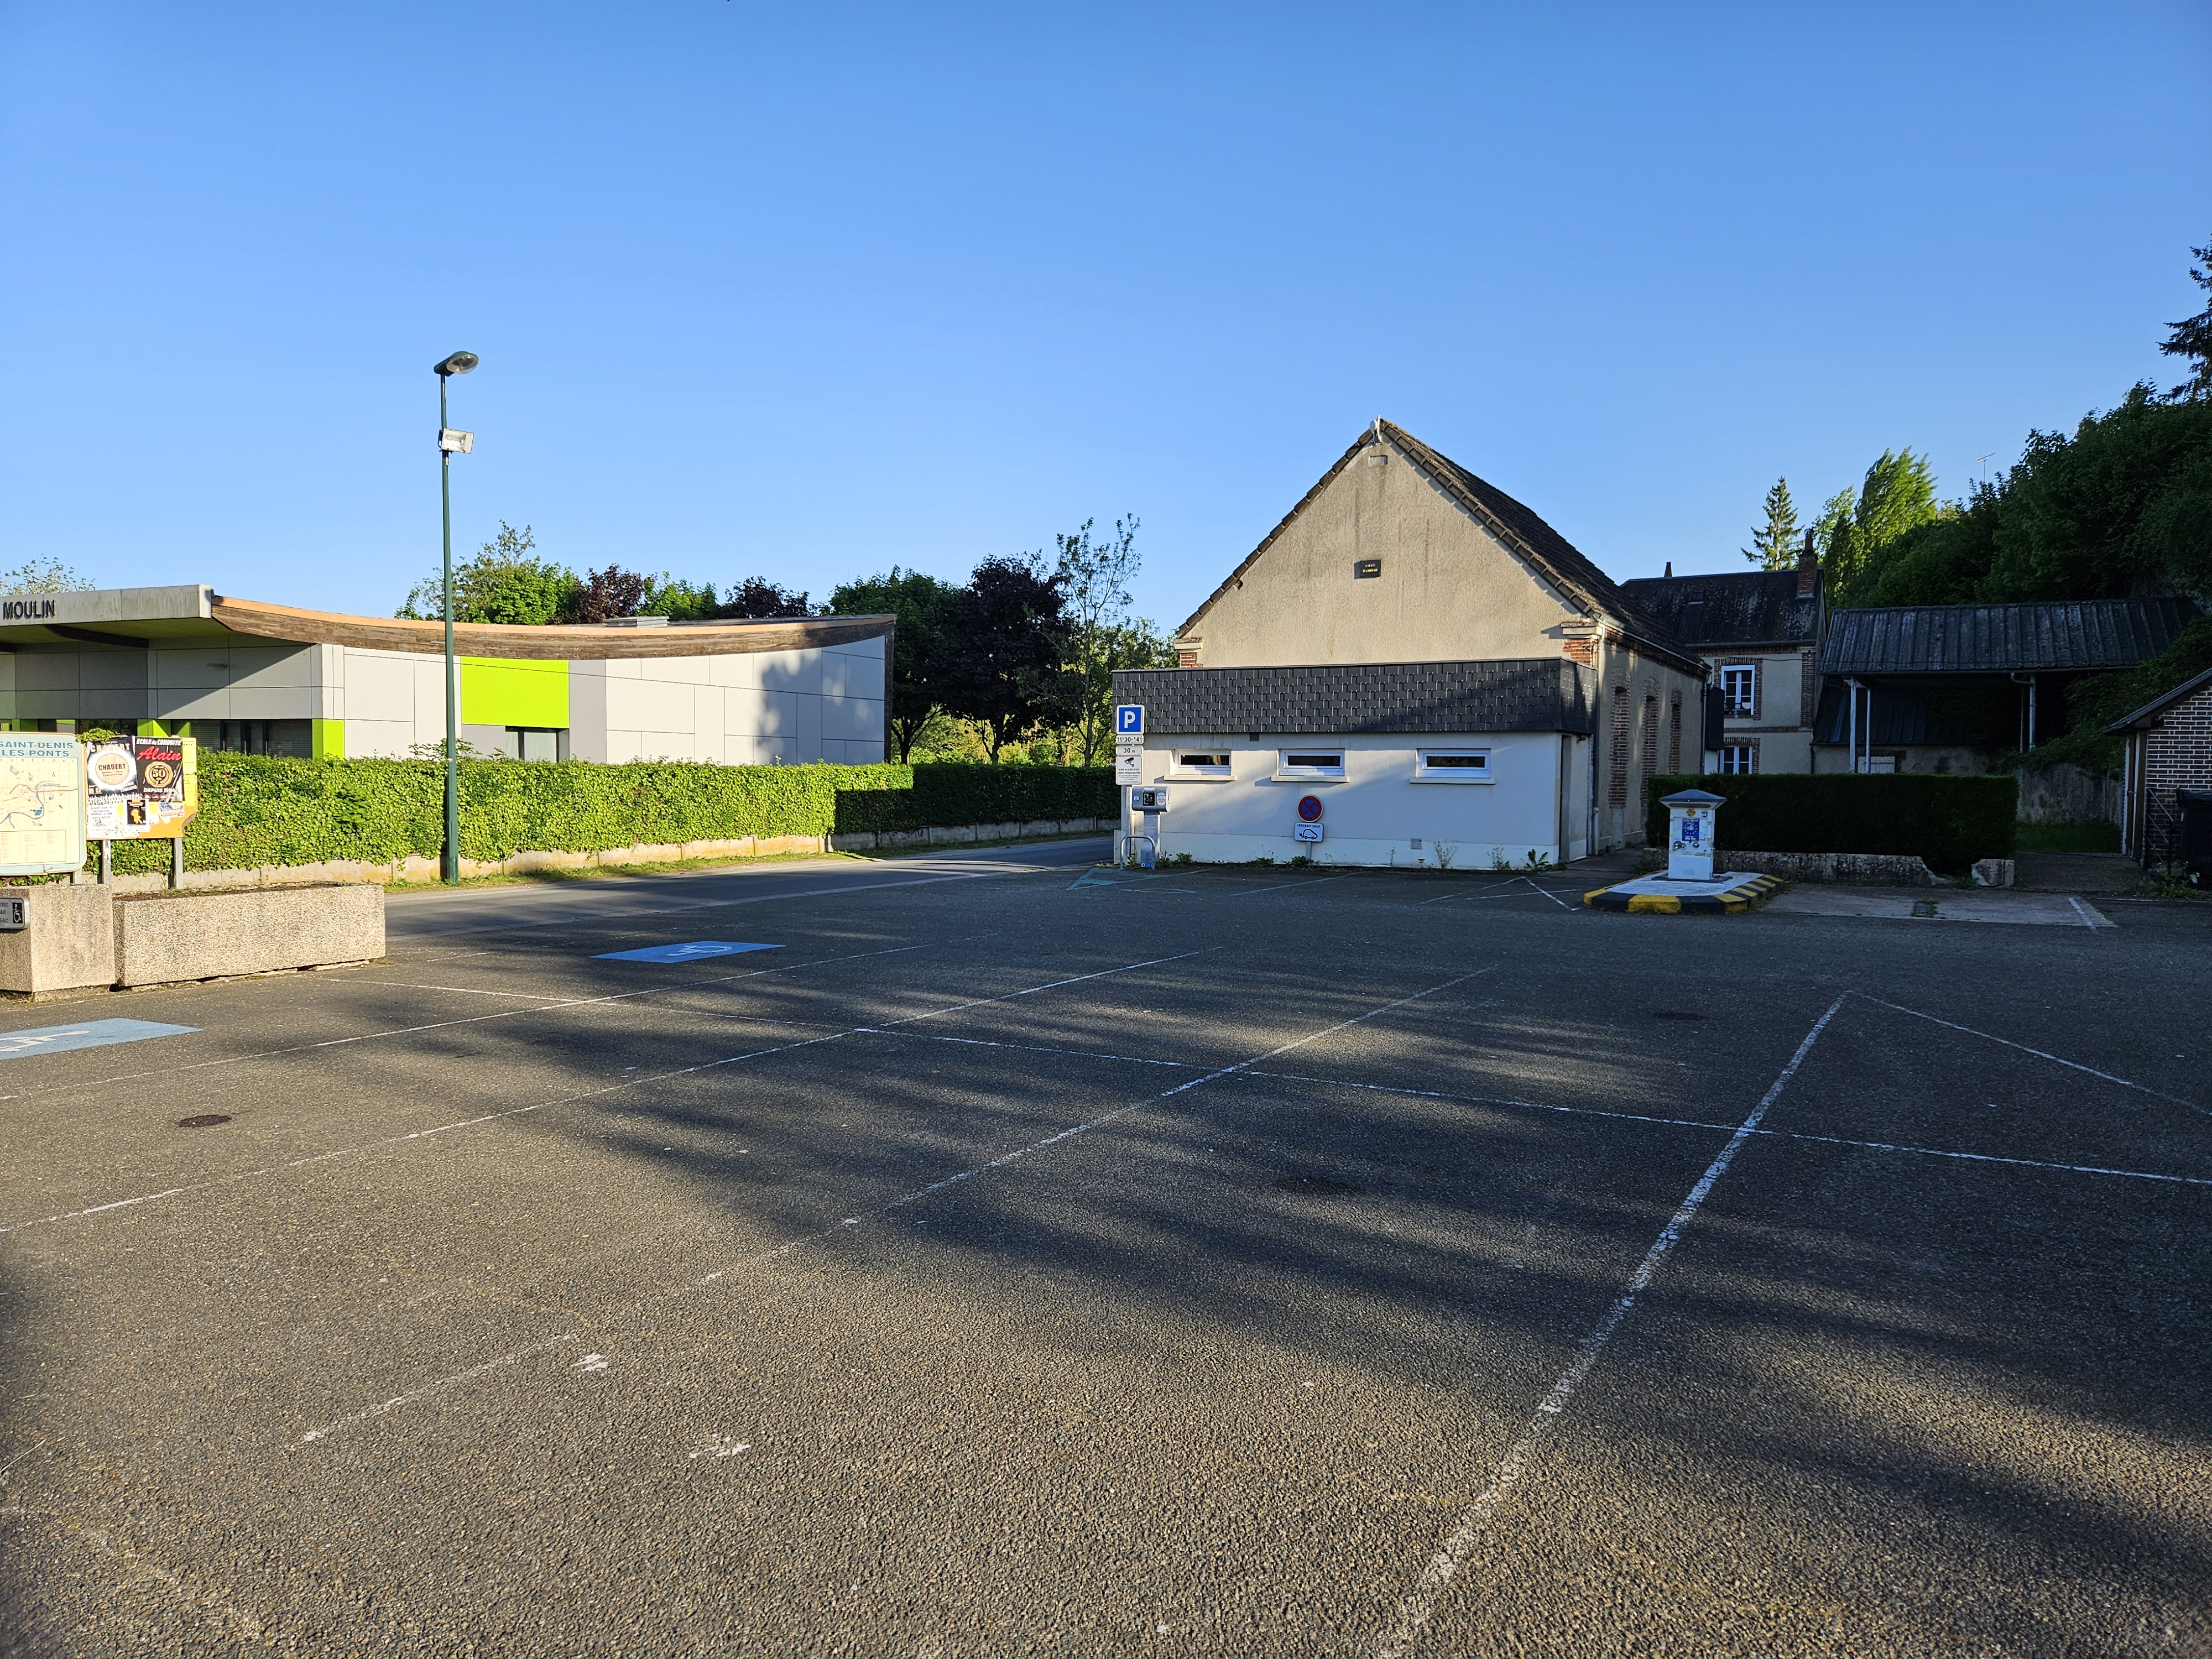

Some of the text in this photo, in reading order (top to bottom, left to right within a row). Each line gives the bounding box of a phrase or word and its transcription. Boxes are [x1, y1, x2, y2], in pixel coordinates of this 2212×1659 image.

[2, 599, 55, 620] MOULIN
[1124, 711, 1136, 729] P
[91, 743, 130, 753] CHABERT
[137, 745, 182, 761] Alain
[152, 769, 166, 778] 50
